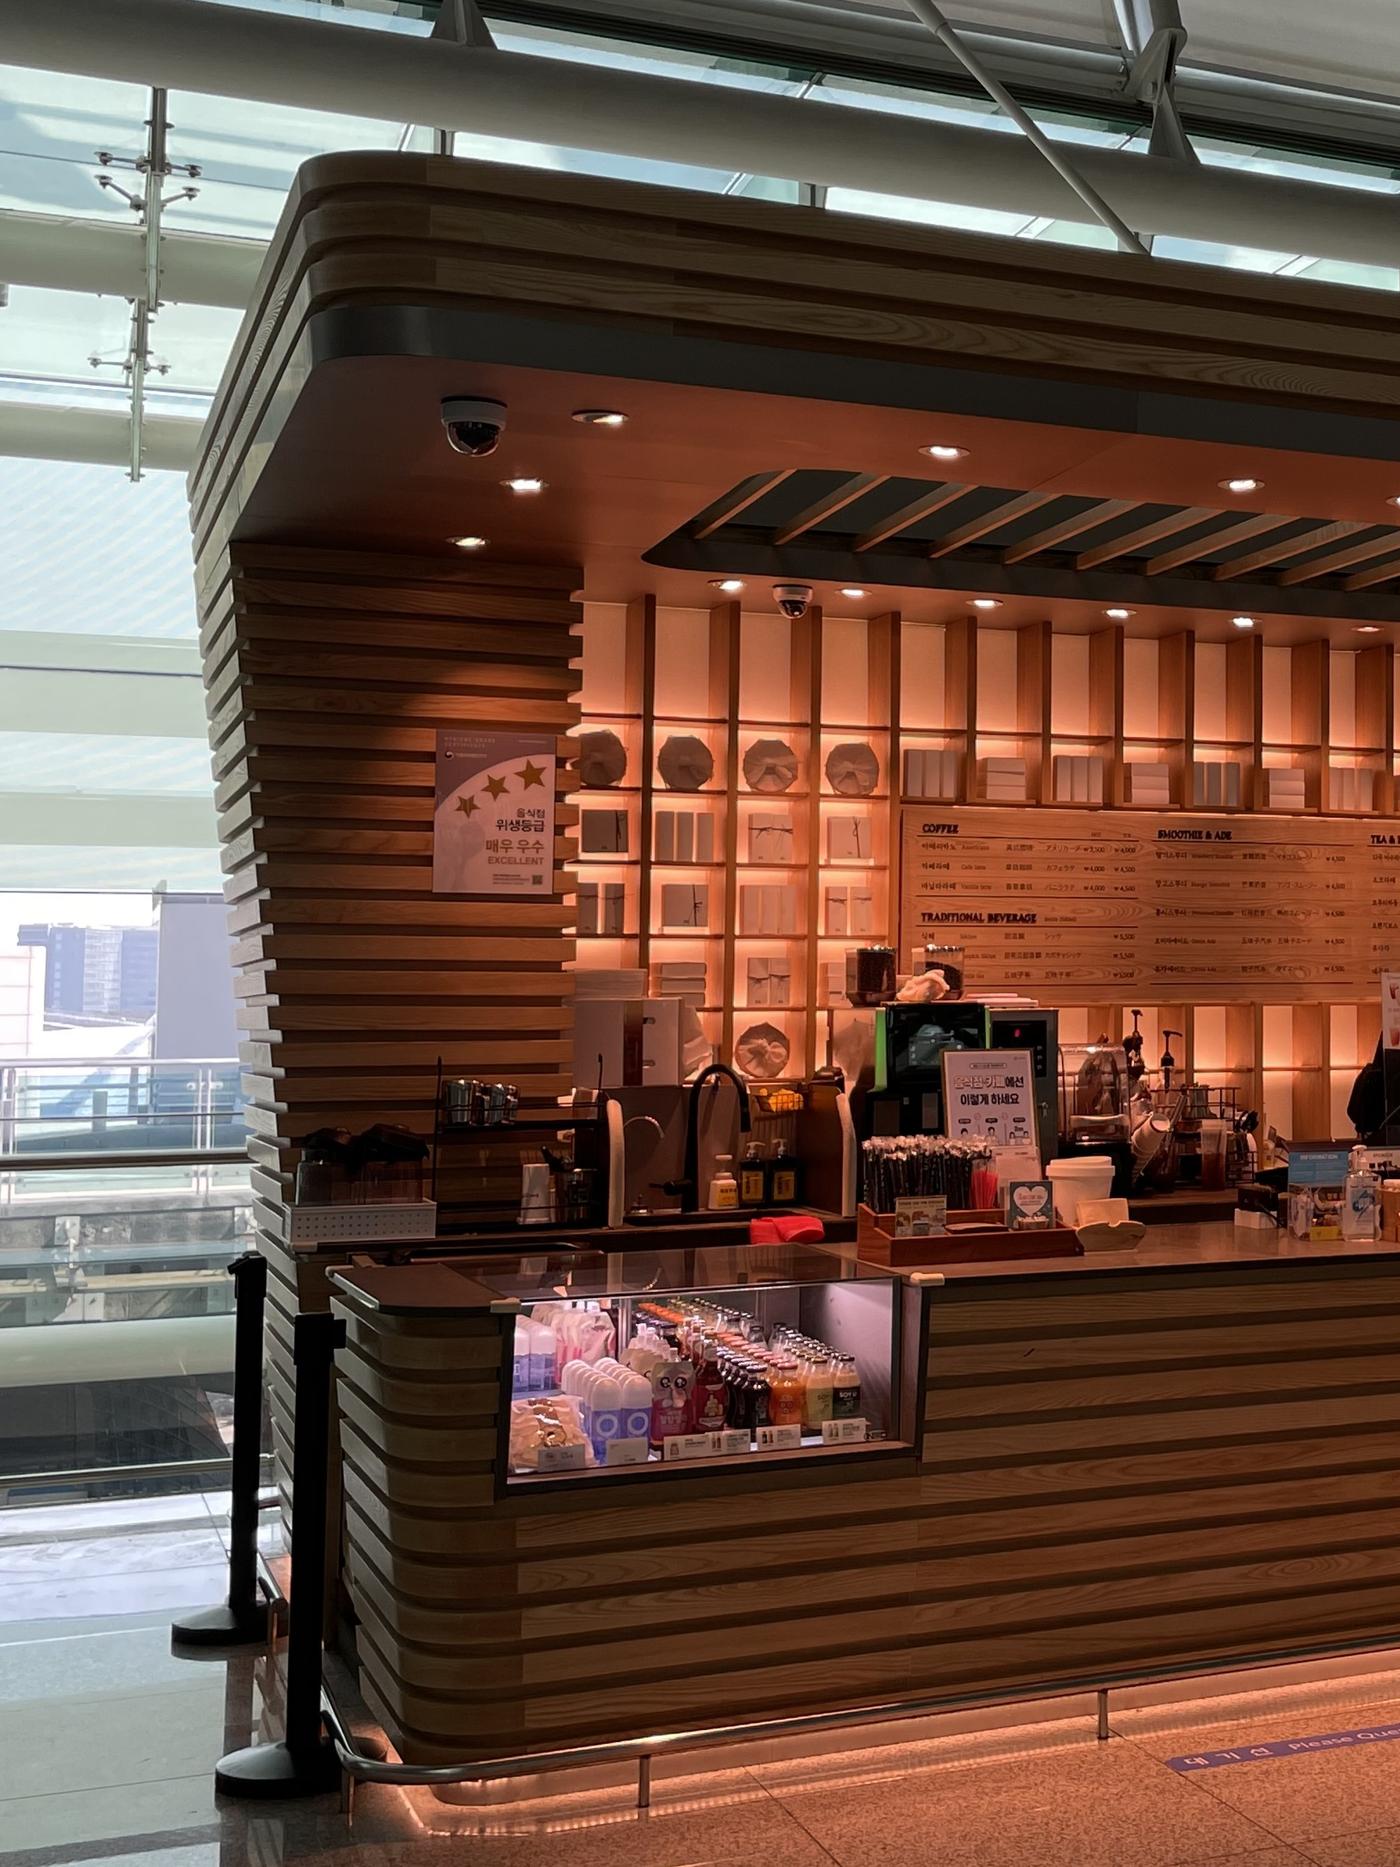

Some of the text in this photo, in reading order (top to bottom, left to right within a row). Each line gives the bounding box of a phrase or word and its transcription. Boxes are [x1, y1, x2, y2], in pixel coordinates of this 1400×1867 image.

[517, 807, 545, 819] 음식점
[495, 819, 545, 832] 위생등급
[922, 824, 960, 834] COFFEE
[1157, 829, 1203, 840] SMOOTHIE
[1214, 831, 1233, 841] ADE
[1370, 834, 1388, 845] TEA
[485, 839, 545, 854] 매우 우수
[487, 856, 545, 865] EXCELLENT
[921, 912, 985, 923] TRADITIONAL
[987, 913, 1037, 924] BEVERAGE
[960, 1093, 1020, 1106] 이렇게 하세요
[1288, 1734, 1353, 1751] Please
